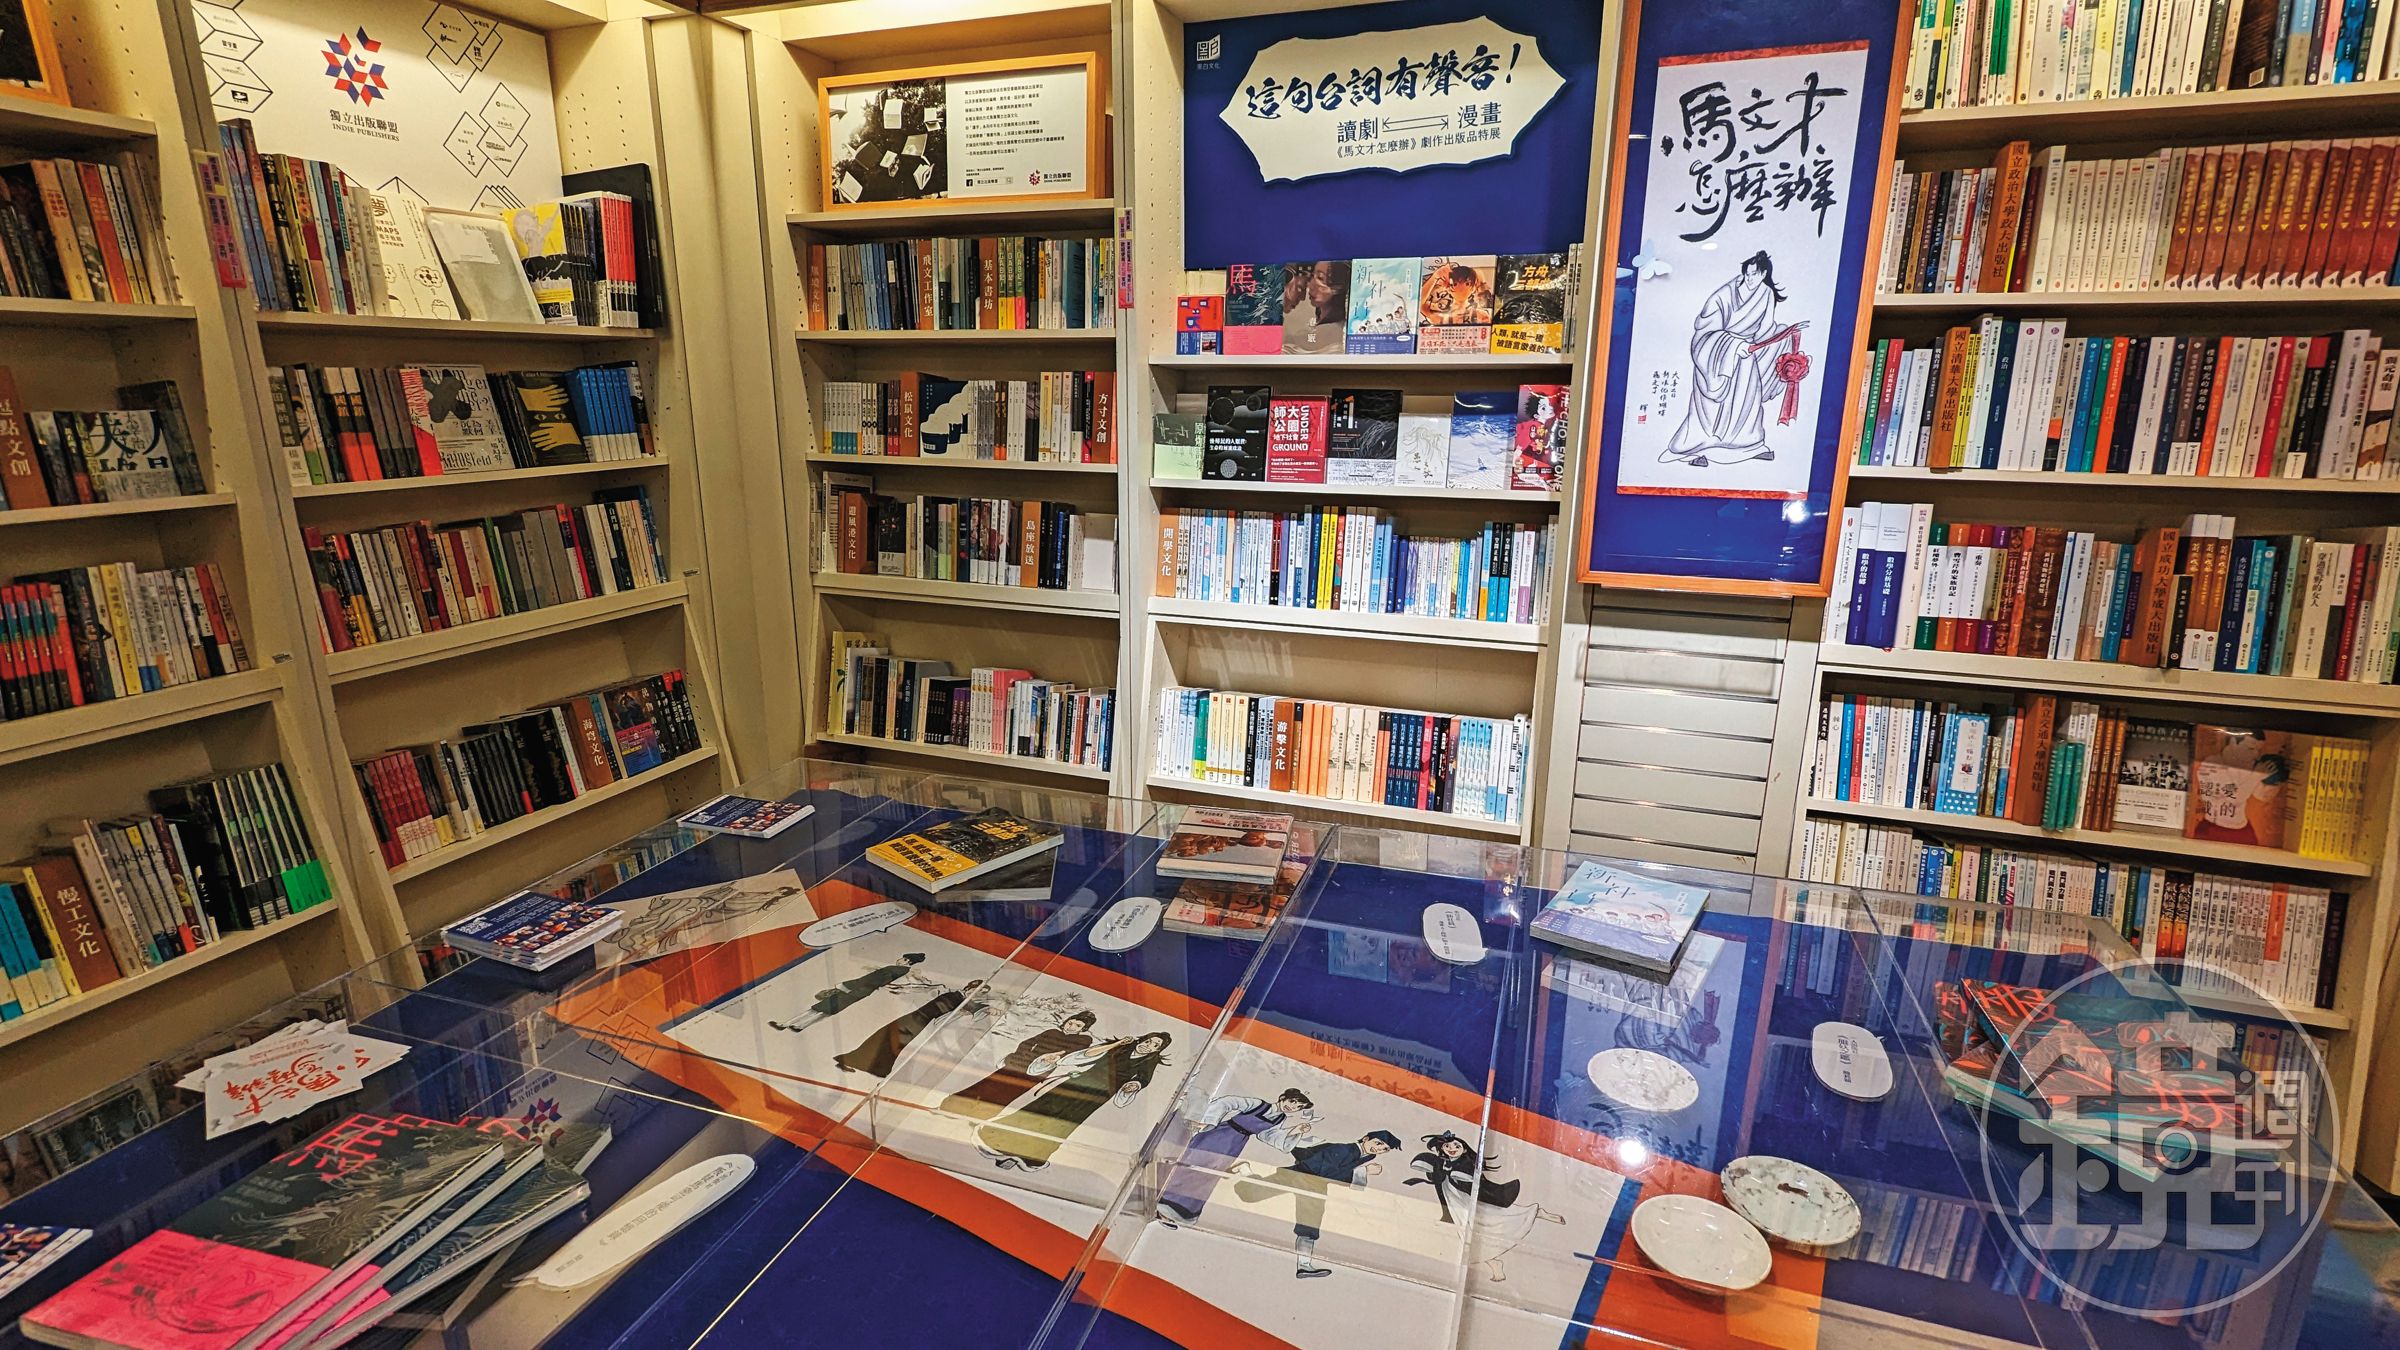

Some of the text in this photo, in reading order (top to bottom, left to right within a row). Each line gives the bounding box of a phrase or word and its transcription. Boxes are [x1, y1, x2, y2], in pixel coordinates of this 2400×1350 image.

[329, 109, 399, 134] 獨立出版聯盟
[332, 123, 400, 142] INDIE PUBLISHERS
[1337, 101, 1502, 143] 讀劇 漫畫
[1660, 71, 1849, 163] 馬文才
[1675, 144, 1837, 242] 怎麼辦
[1993, 143, 2025, 278] 國立政治大學政大出版社
[982, 258, 994, 311] 基本書坊
[1523, 264, 1549, 278] 方舟
[1940, 331, 1967, 432] 國立清華大學出版社
[903, 392, 914, 438] 松鼠文化
[1096, 393, 1110, 444] 方寸文創
[1274, 406, 1299, 419] 師大
[1274, 419, 1299, 433] 公園
[1300, 405, 1310, 440] UNDER
[1556, 411, 1569, 463] CHOEN
[1272, 443, 1309, 452] GROUND
[1024, 519, 1036, 565] 島座放送
[1161, 527, 1174, 577] 開學文化
[2145, 531, 2177, 655] 國立成功大學成大出版社
[1274, 720, 1288, 771] 游擊文化
[2031, 696, 2053, 793] 國立交通大學出版社
